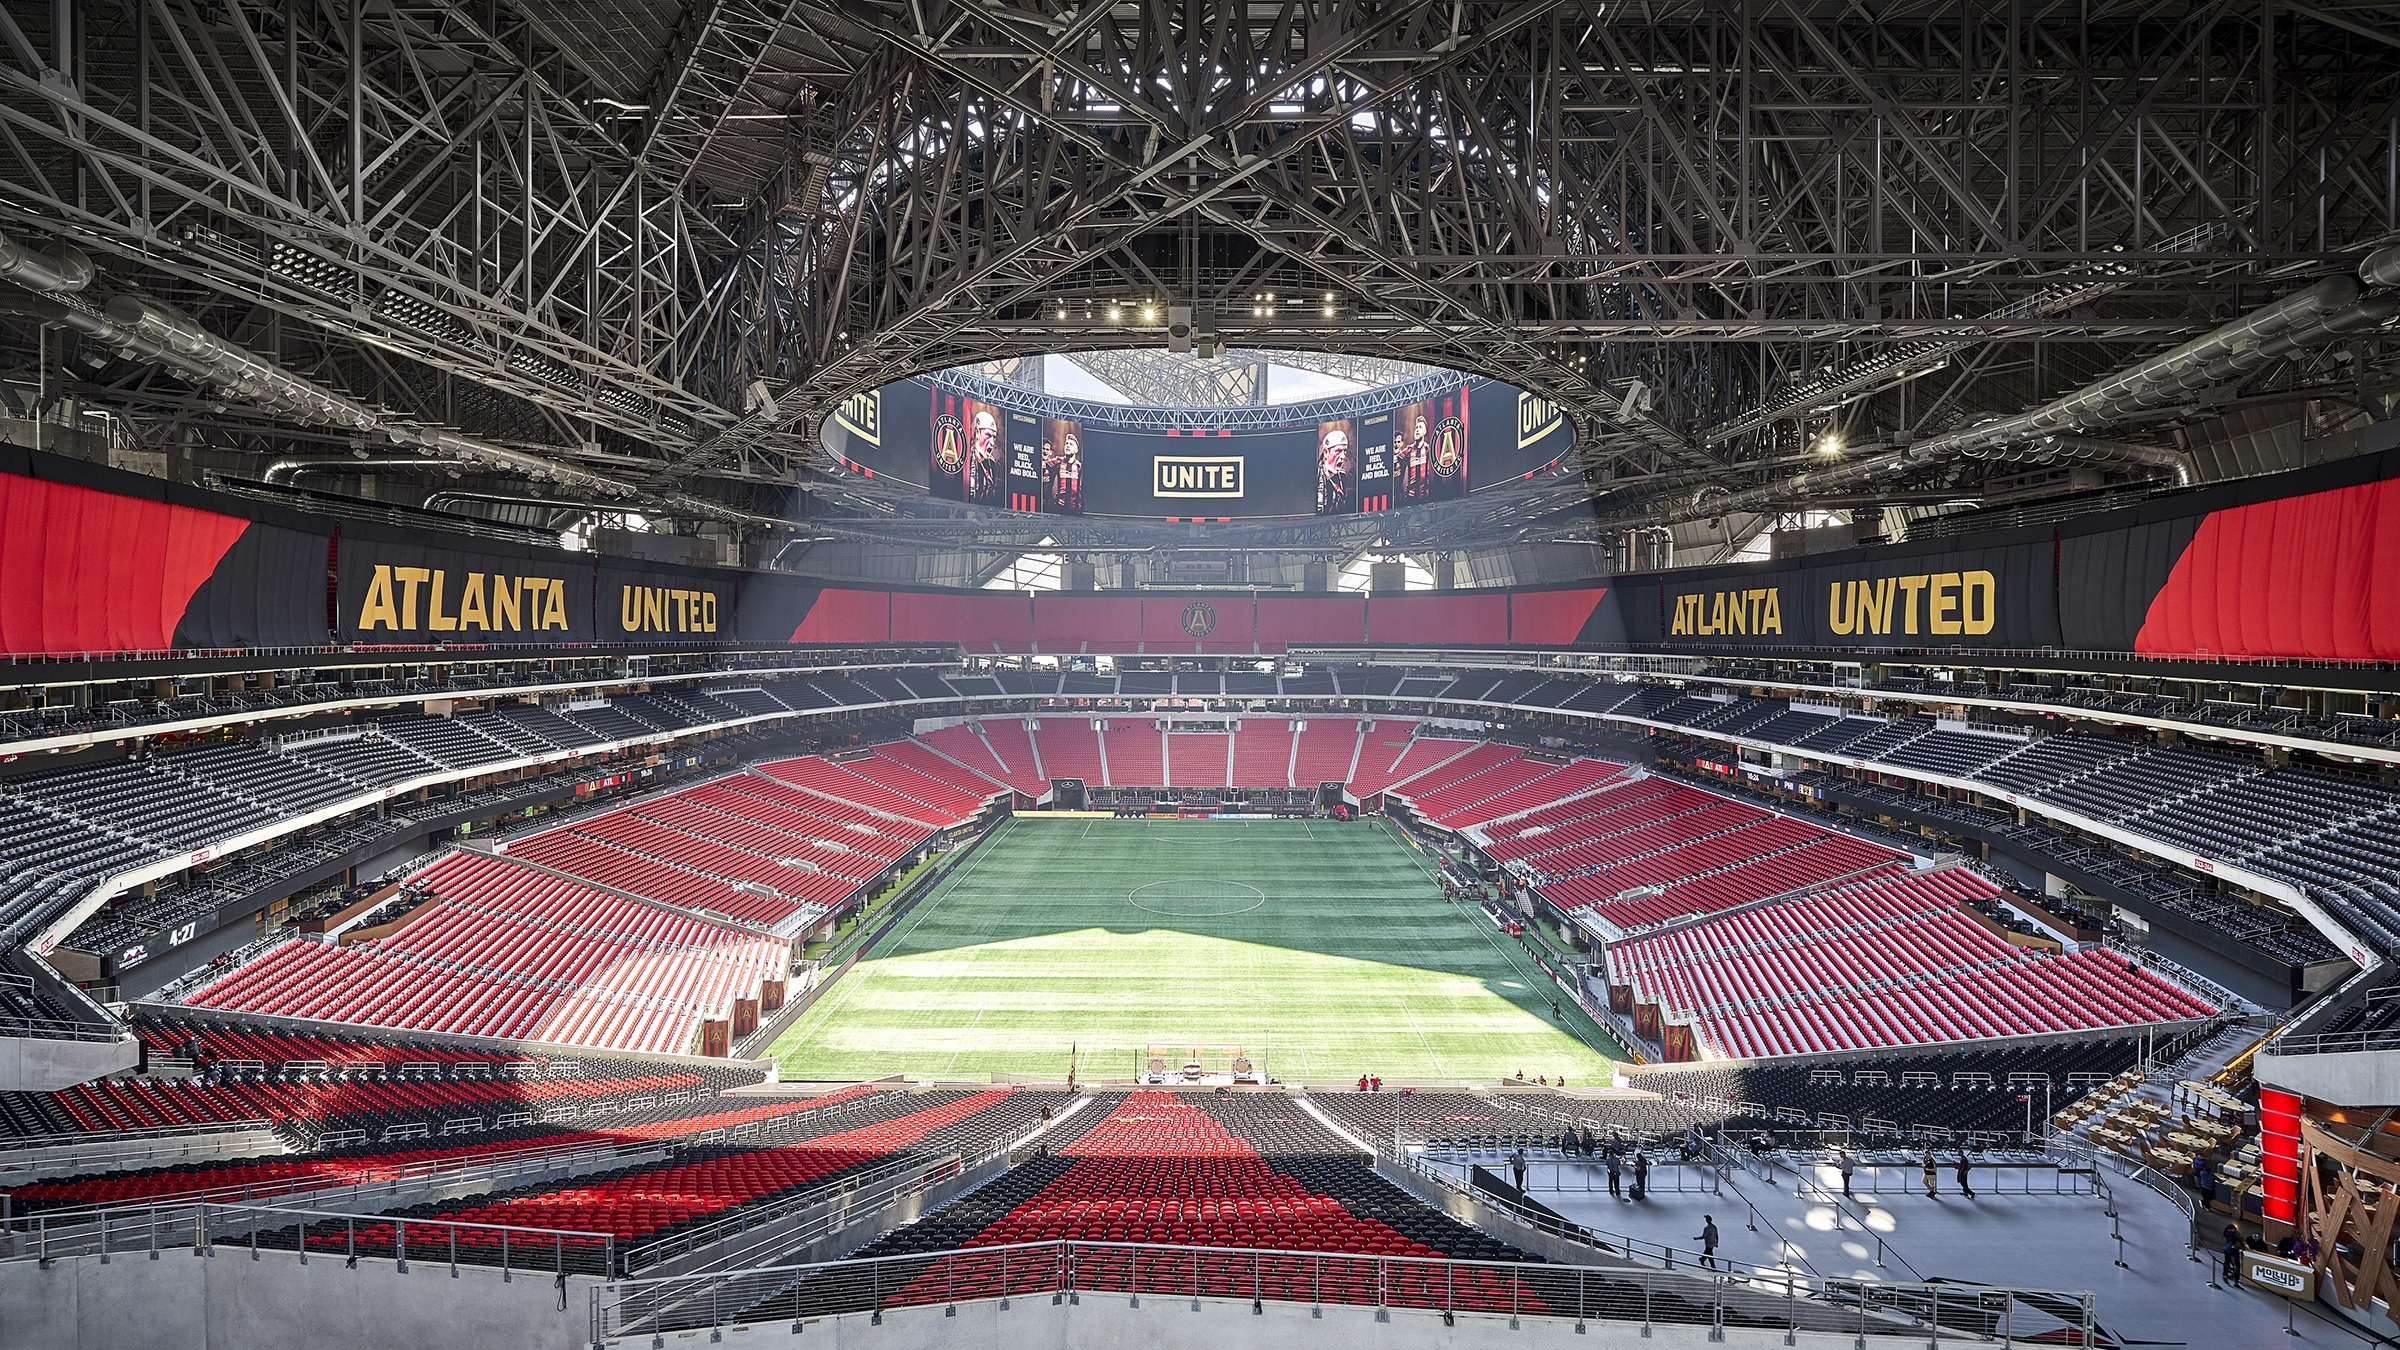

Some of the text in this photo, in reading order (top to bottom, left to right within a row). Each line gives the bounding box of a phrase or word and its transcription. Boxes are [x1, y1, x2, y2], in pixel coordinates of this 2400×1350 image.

[1523, 397, 1558, 433] UNI
[938, 416, 963, 433] ATLANTA
[1435, 419, 1460, 435] ATLANTA
[1013, 442, 1035, 454] WE ARE
[1365, 444, 1387, 456] WE ARE
[1014, 460, 1034, 470] BLACK,
[1365, 462, 1386, 472] BLACK,
[1009, 468, 1039, 479] AND BOLD.
[1162, 465, 1235, 489] UNITE
[1361, 469, 1390, 481] AND BOLD.
[358, 564, 569, 632] ATLANTA
[1829, 569, 1996, 636] UNITED
[621, 585, 718, 634] UNITED
[1187, 602, 1212, 611] ATLANTA
[1671, 586, 1783, 636] ATLANTA
[1714, 764, 1724, 773] ATL
[603, 778, 614, 787] ATL
[1784, 781, 1794, 790] PHI
[169, 922, 196, 946] 4:27
